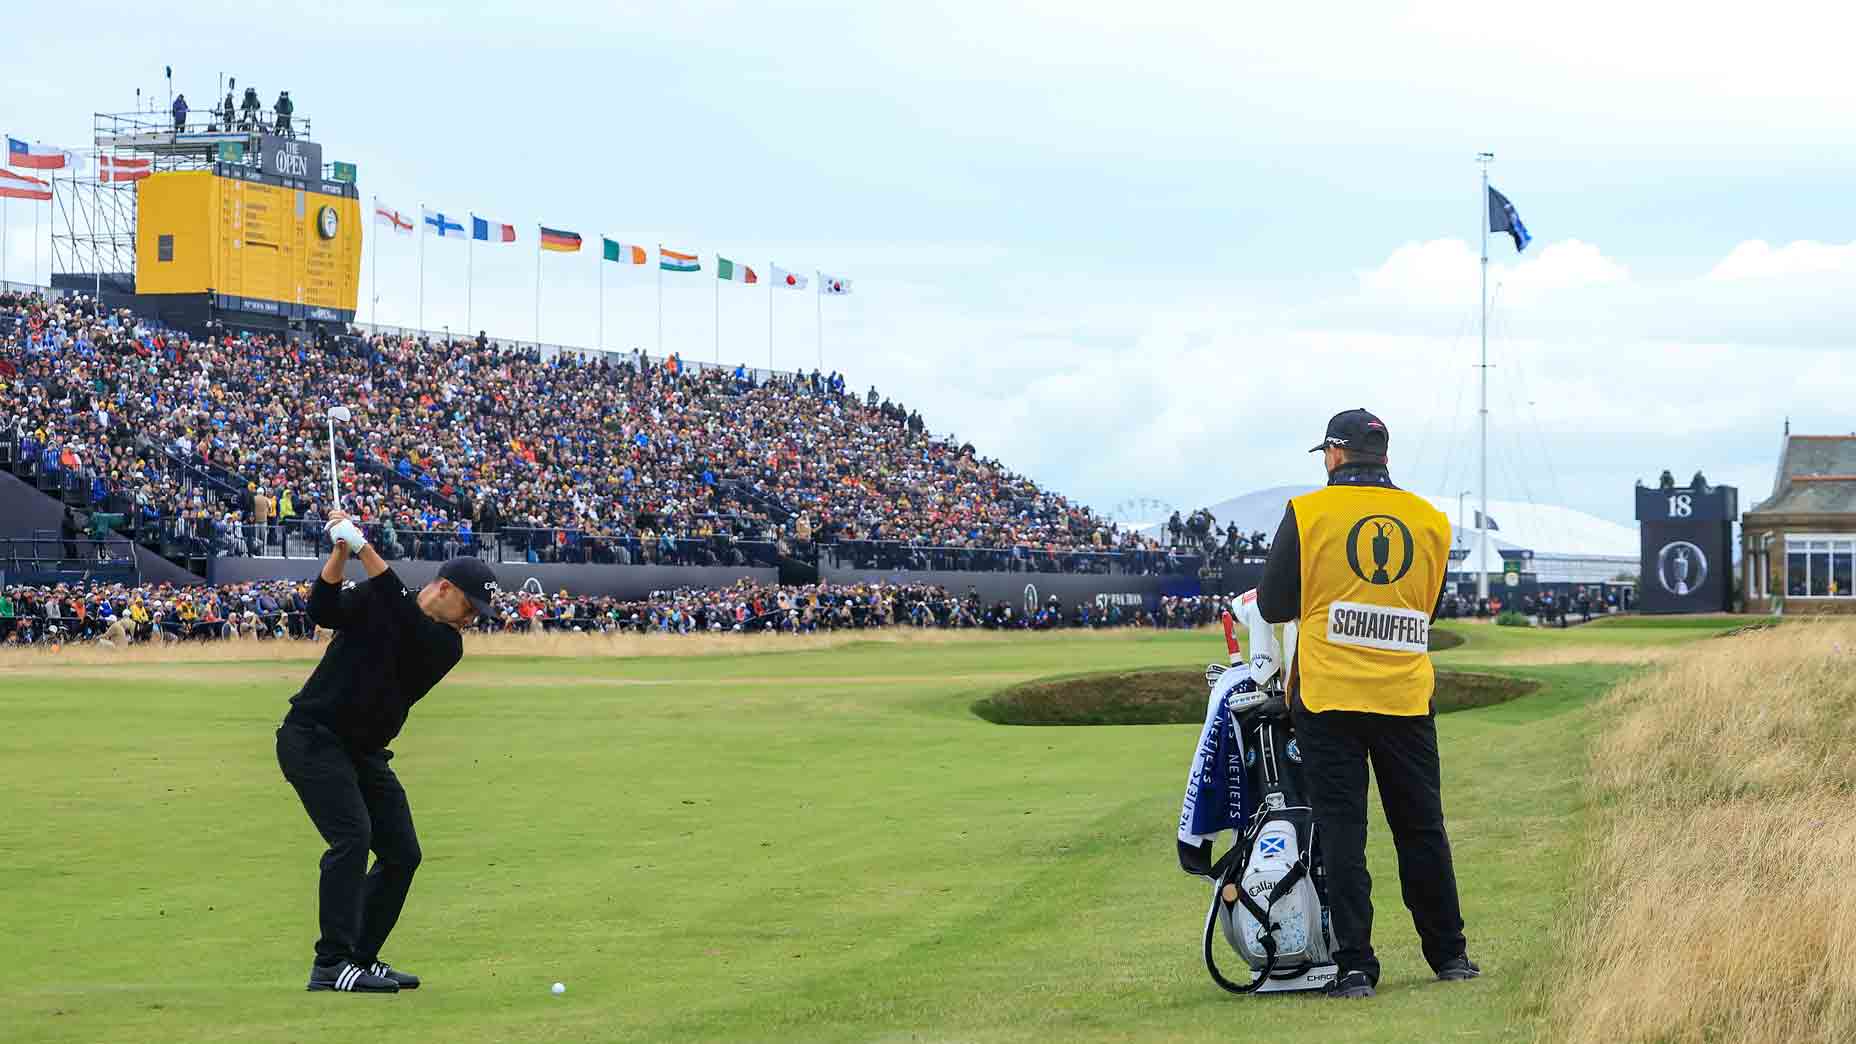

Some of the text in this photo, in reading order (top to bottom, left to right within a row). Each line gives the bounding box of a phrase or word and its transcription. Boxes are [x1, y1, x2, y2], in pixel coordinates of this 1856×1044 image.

[285, 142, 301, 154] THE
[276, 150, 308, 176] OPEN
[1668, 494, 1692, 517] 18
[1333, 608, 1426, 645] SCHAUFFELE
[1248, 880, 1295, 897] Calla
